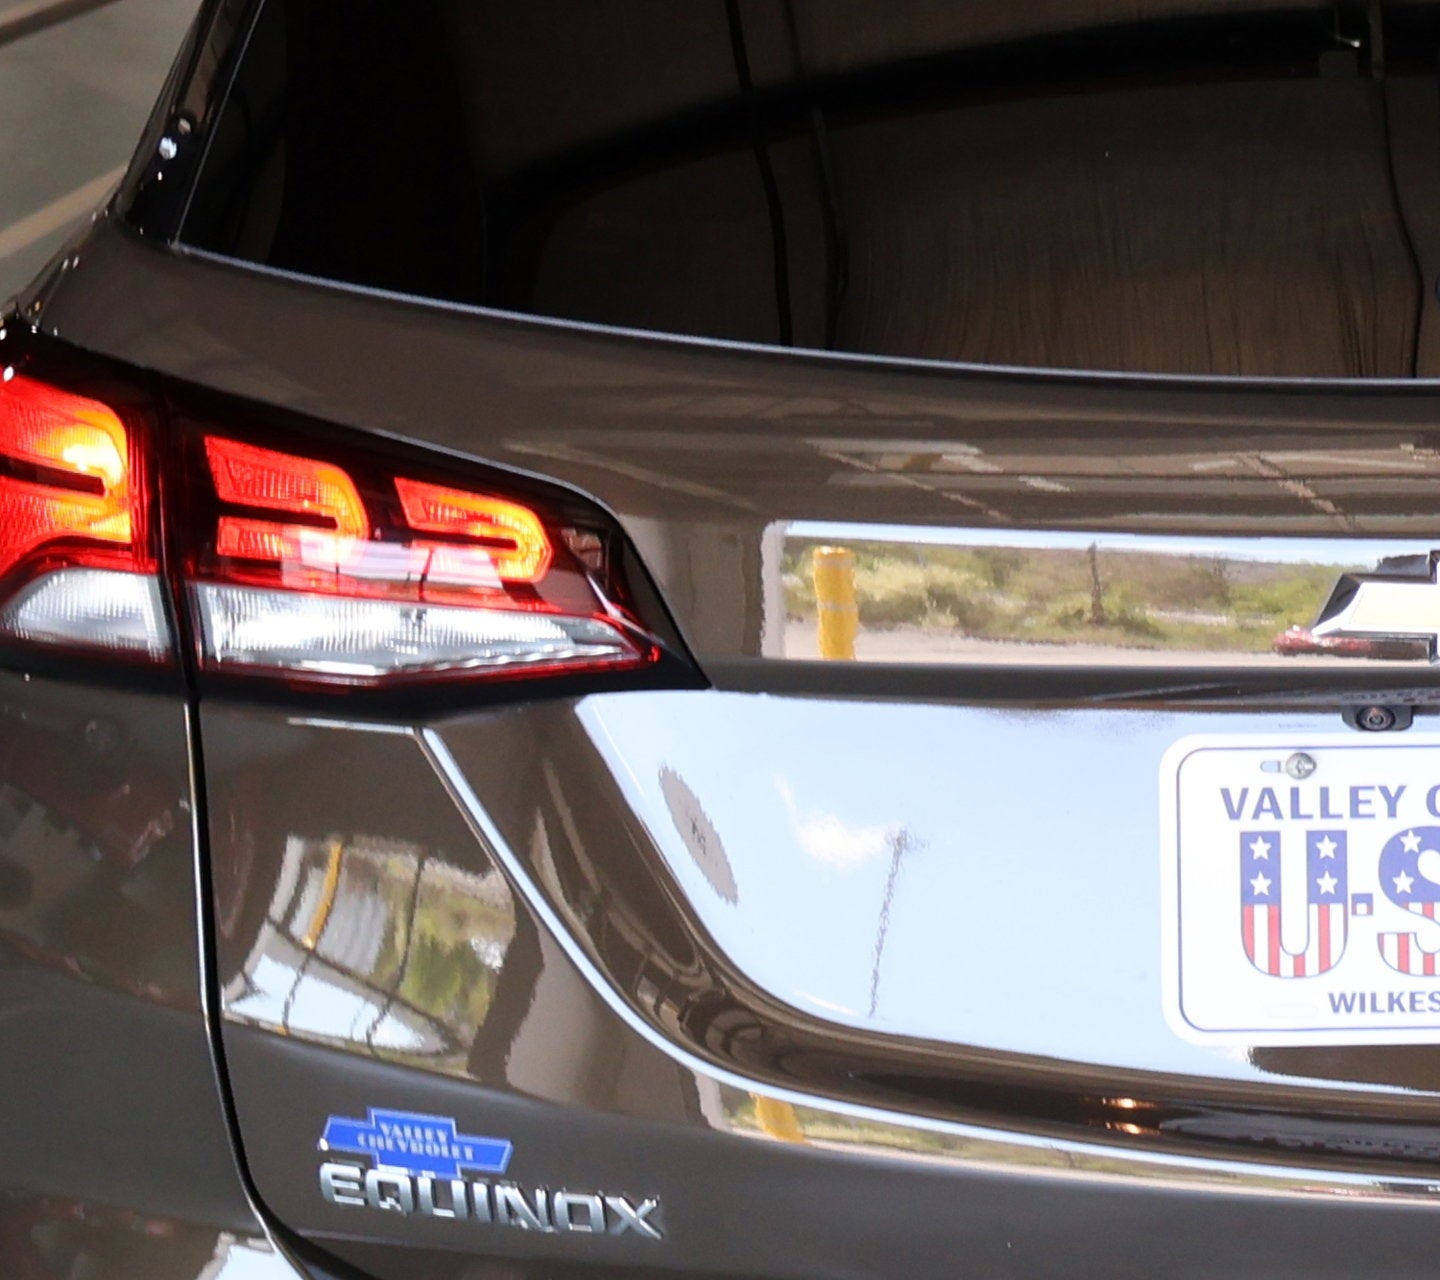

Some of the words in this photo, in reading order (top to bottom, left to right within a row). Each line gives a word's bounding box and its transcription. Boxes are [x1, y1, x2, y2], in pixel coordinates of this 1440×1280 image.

[1220, 785, 1407, 821] VALLEY
[357, 1132, 474, 1161] CHEVROLET
[379, 1122, 449, 1143] VALLEY
[318, 1162, 664, 1239] EQUINOX
